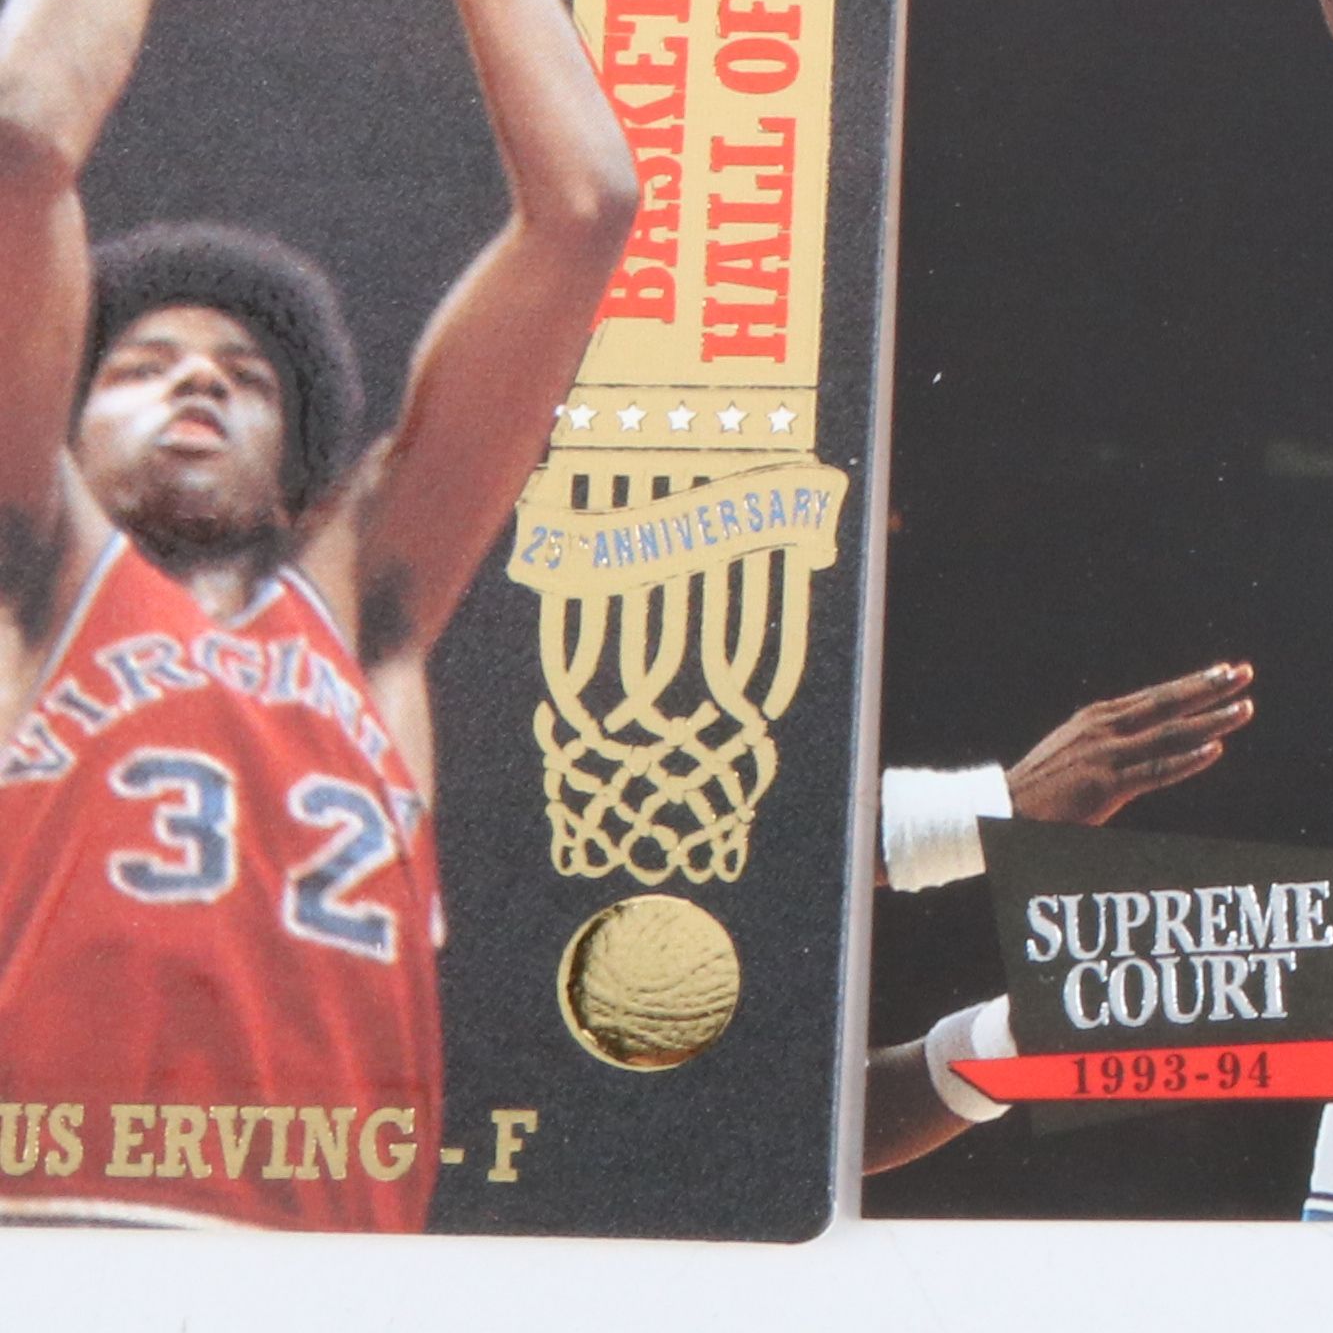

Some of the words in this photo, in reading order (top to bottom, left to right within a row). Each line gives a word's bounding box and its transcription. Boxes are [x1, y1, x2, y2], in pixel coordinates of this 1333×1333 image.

[701, 117, 796, 363] HALL
[592, 487, 831, 570] ANNIVERSARY
[106, 744, 399, 966] 32
[1062, 951, 1297, 1030] COURT
[1072, 1050, 1273, 1095] 1993-94
[105, 1103, 418, 1182] ERVING
[487, 1108, 538, 1183] F
